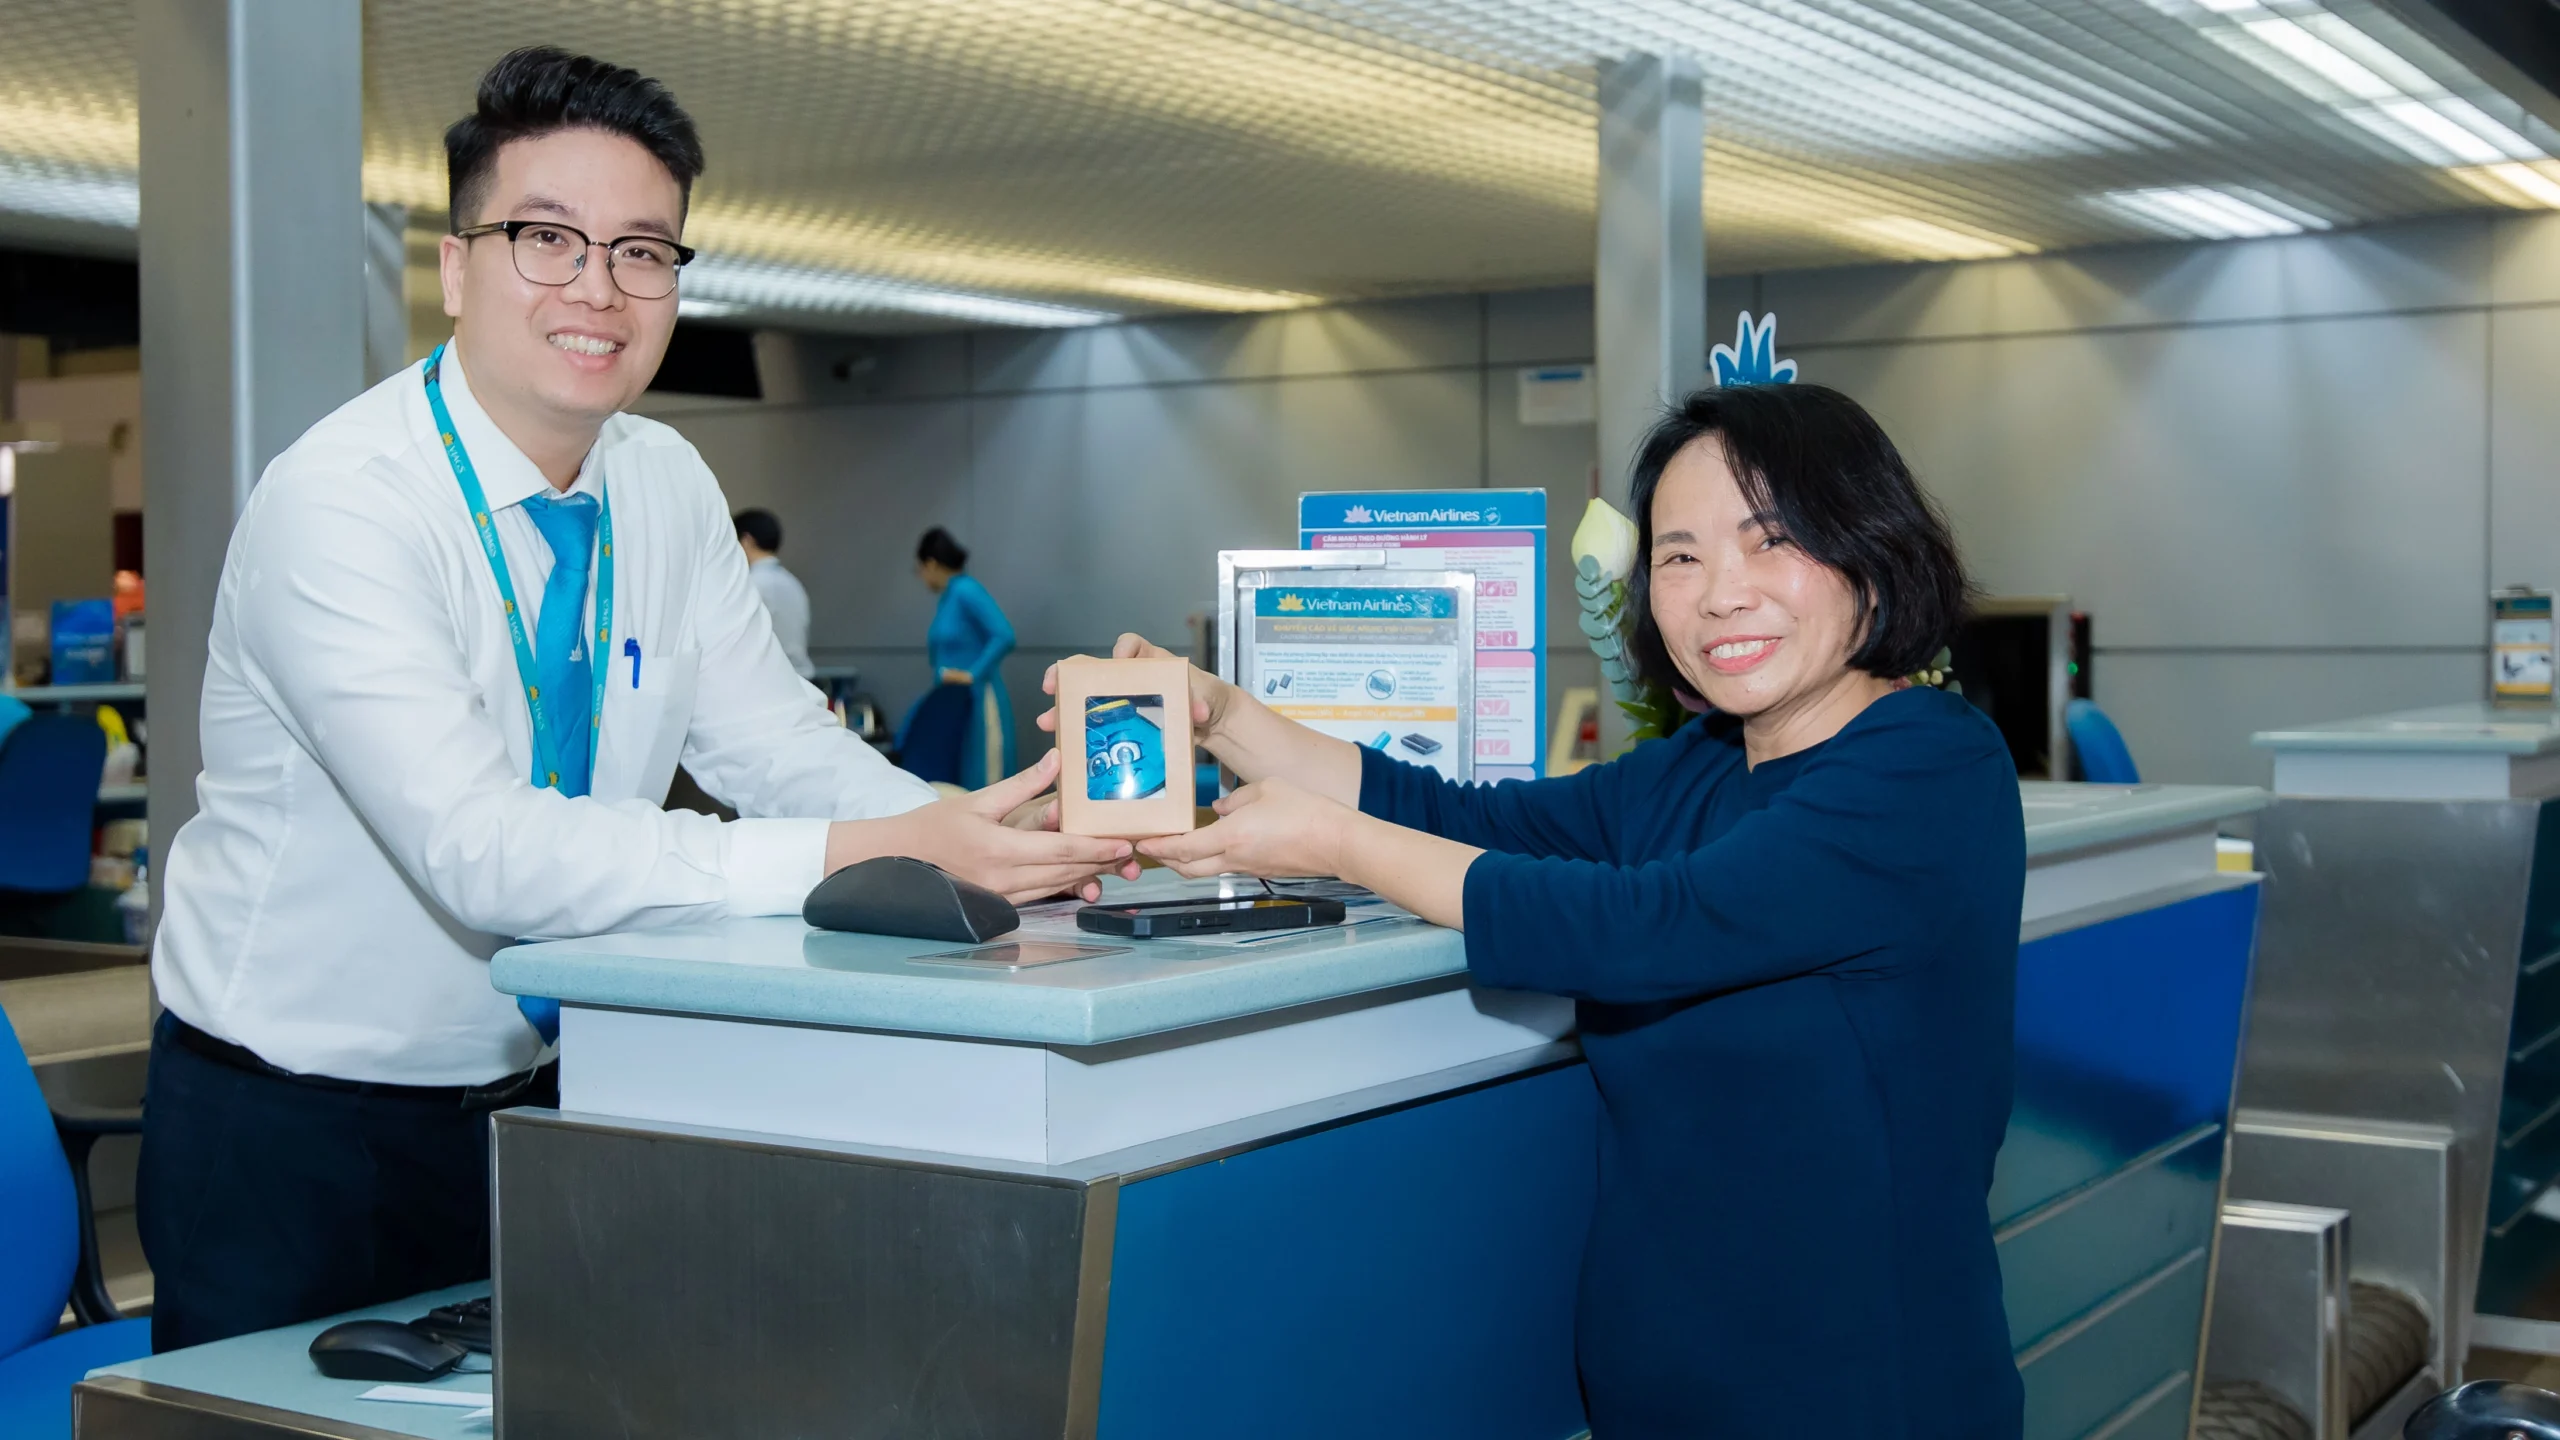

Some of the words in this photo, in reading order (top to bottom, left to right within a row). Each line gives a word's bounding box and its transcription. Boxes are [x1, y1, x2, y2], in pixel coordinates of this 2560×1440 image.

[449, 445, 466, 474] VIAGS
[1373, 508, 1428, 523] Vietnam
[1429, 508, 1480, 522] Airlines
[1306, 598, 1362, 612] Vietnam
[1363, 598, 1413, 612] Airlines
